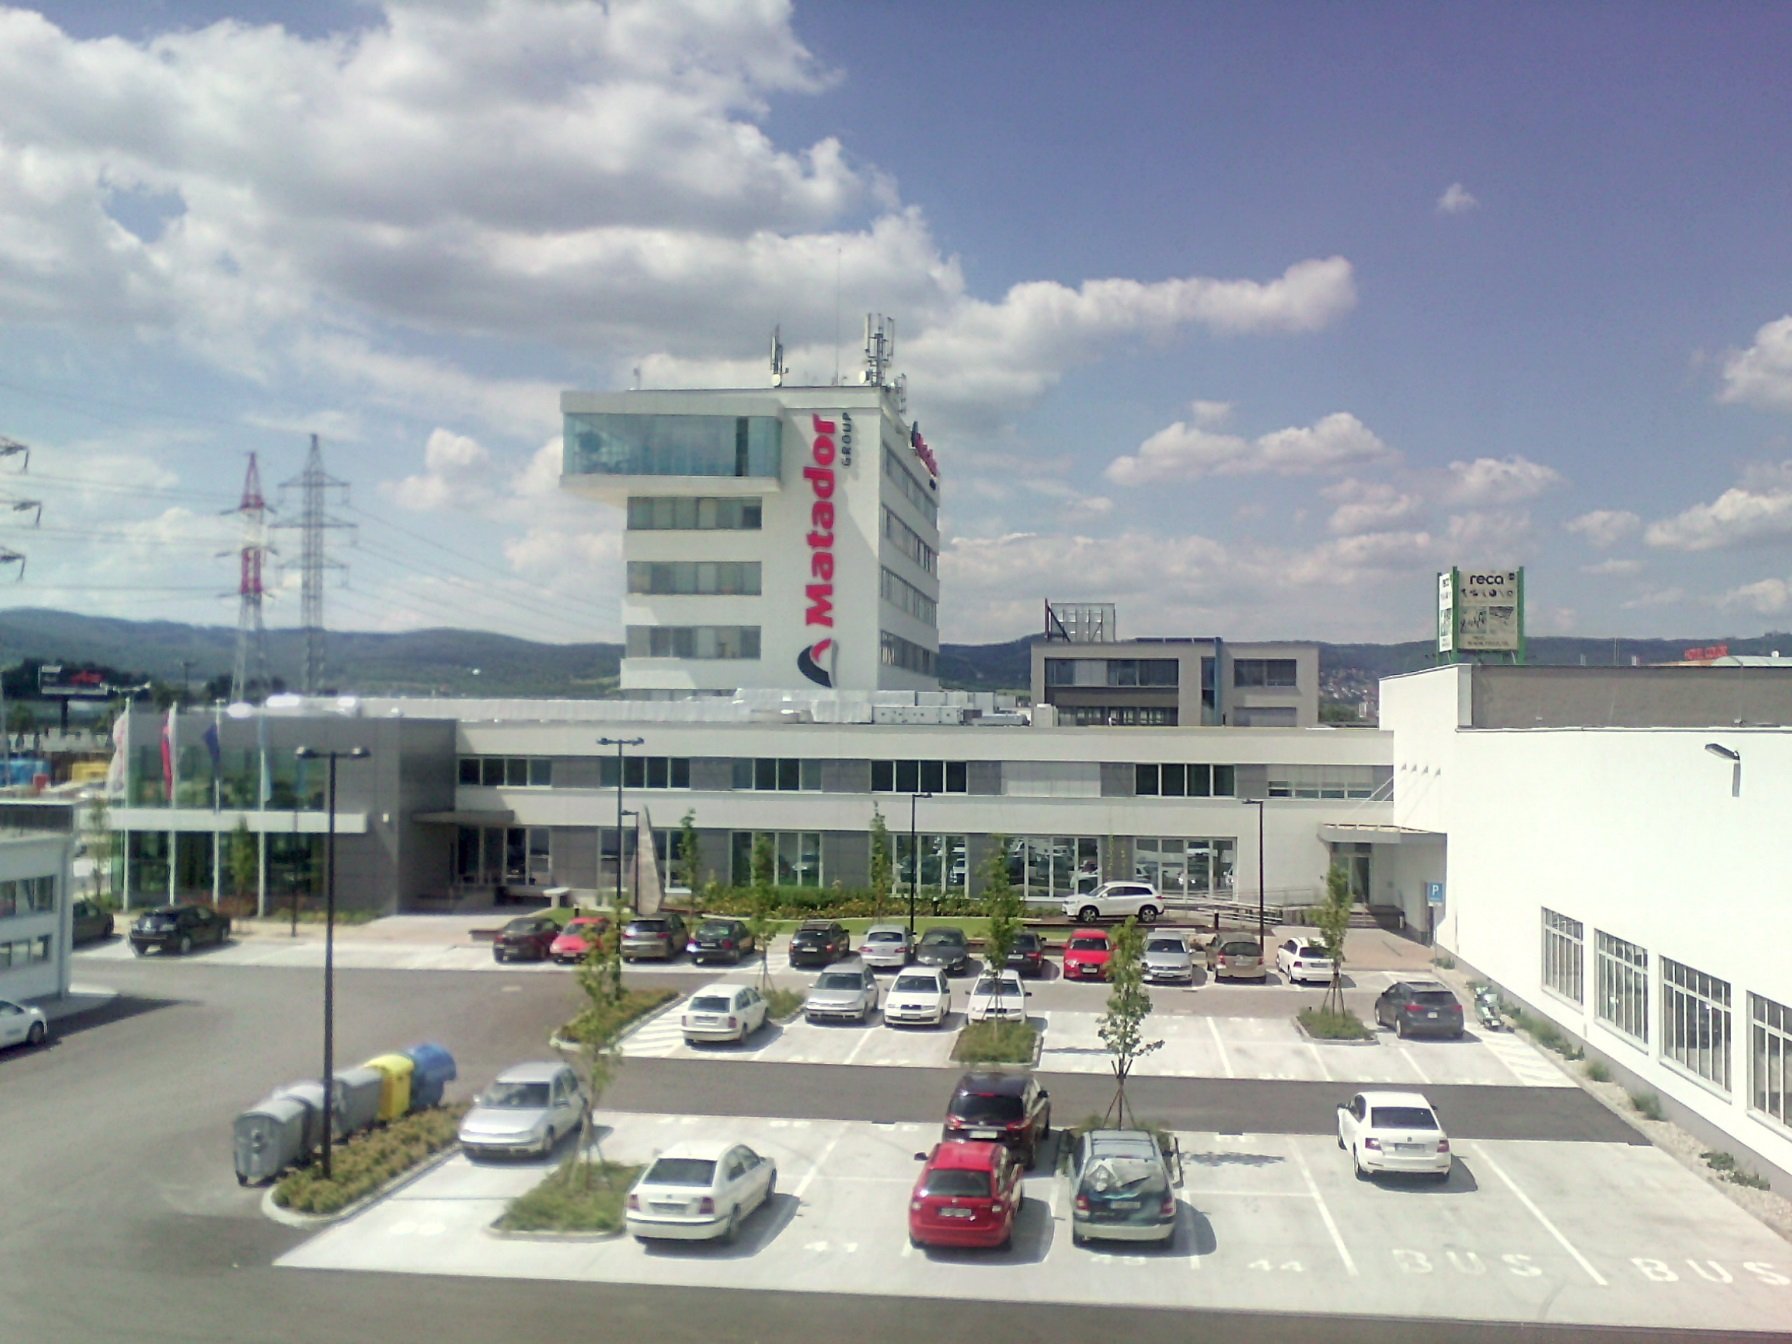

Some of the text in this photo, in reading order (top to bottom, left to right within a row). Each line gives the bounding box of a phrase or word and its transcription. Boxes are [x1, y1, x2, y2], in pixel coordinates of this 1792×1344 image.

[841, 412, 852, 467] GROUP
[803, 413, 836, 628] Matador
[1469, 575, 1504, 585] reca
[1432, 884, 1439, 896] P
[1392, 1248, 1543, 1277] BUS
[1630, 1256, 1792, 1286] BUS
